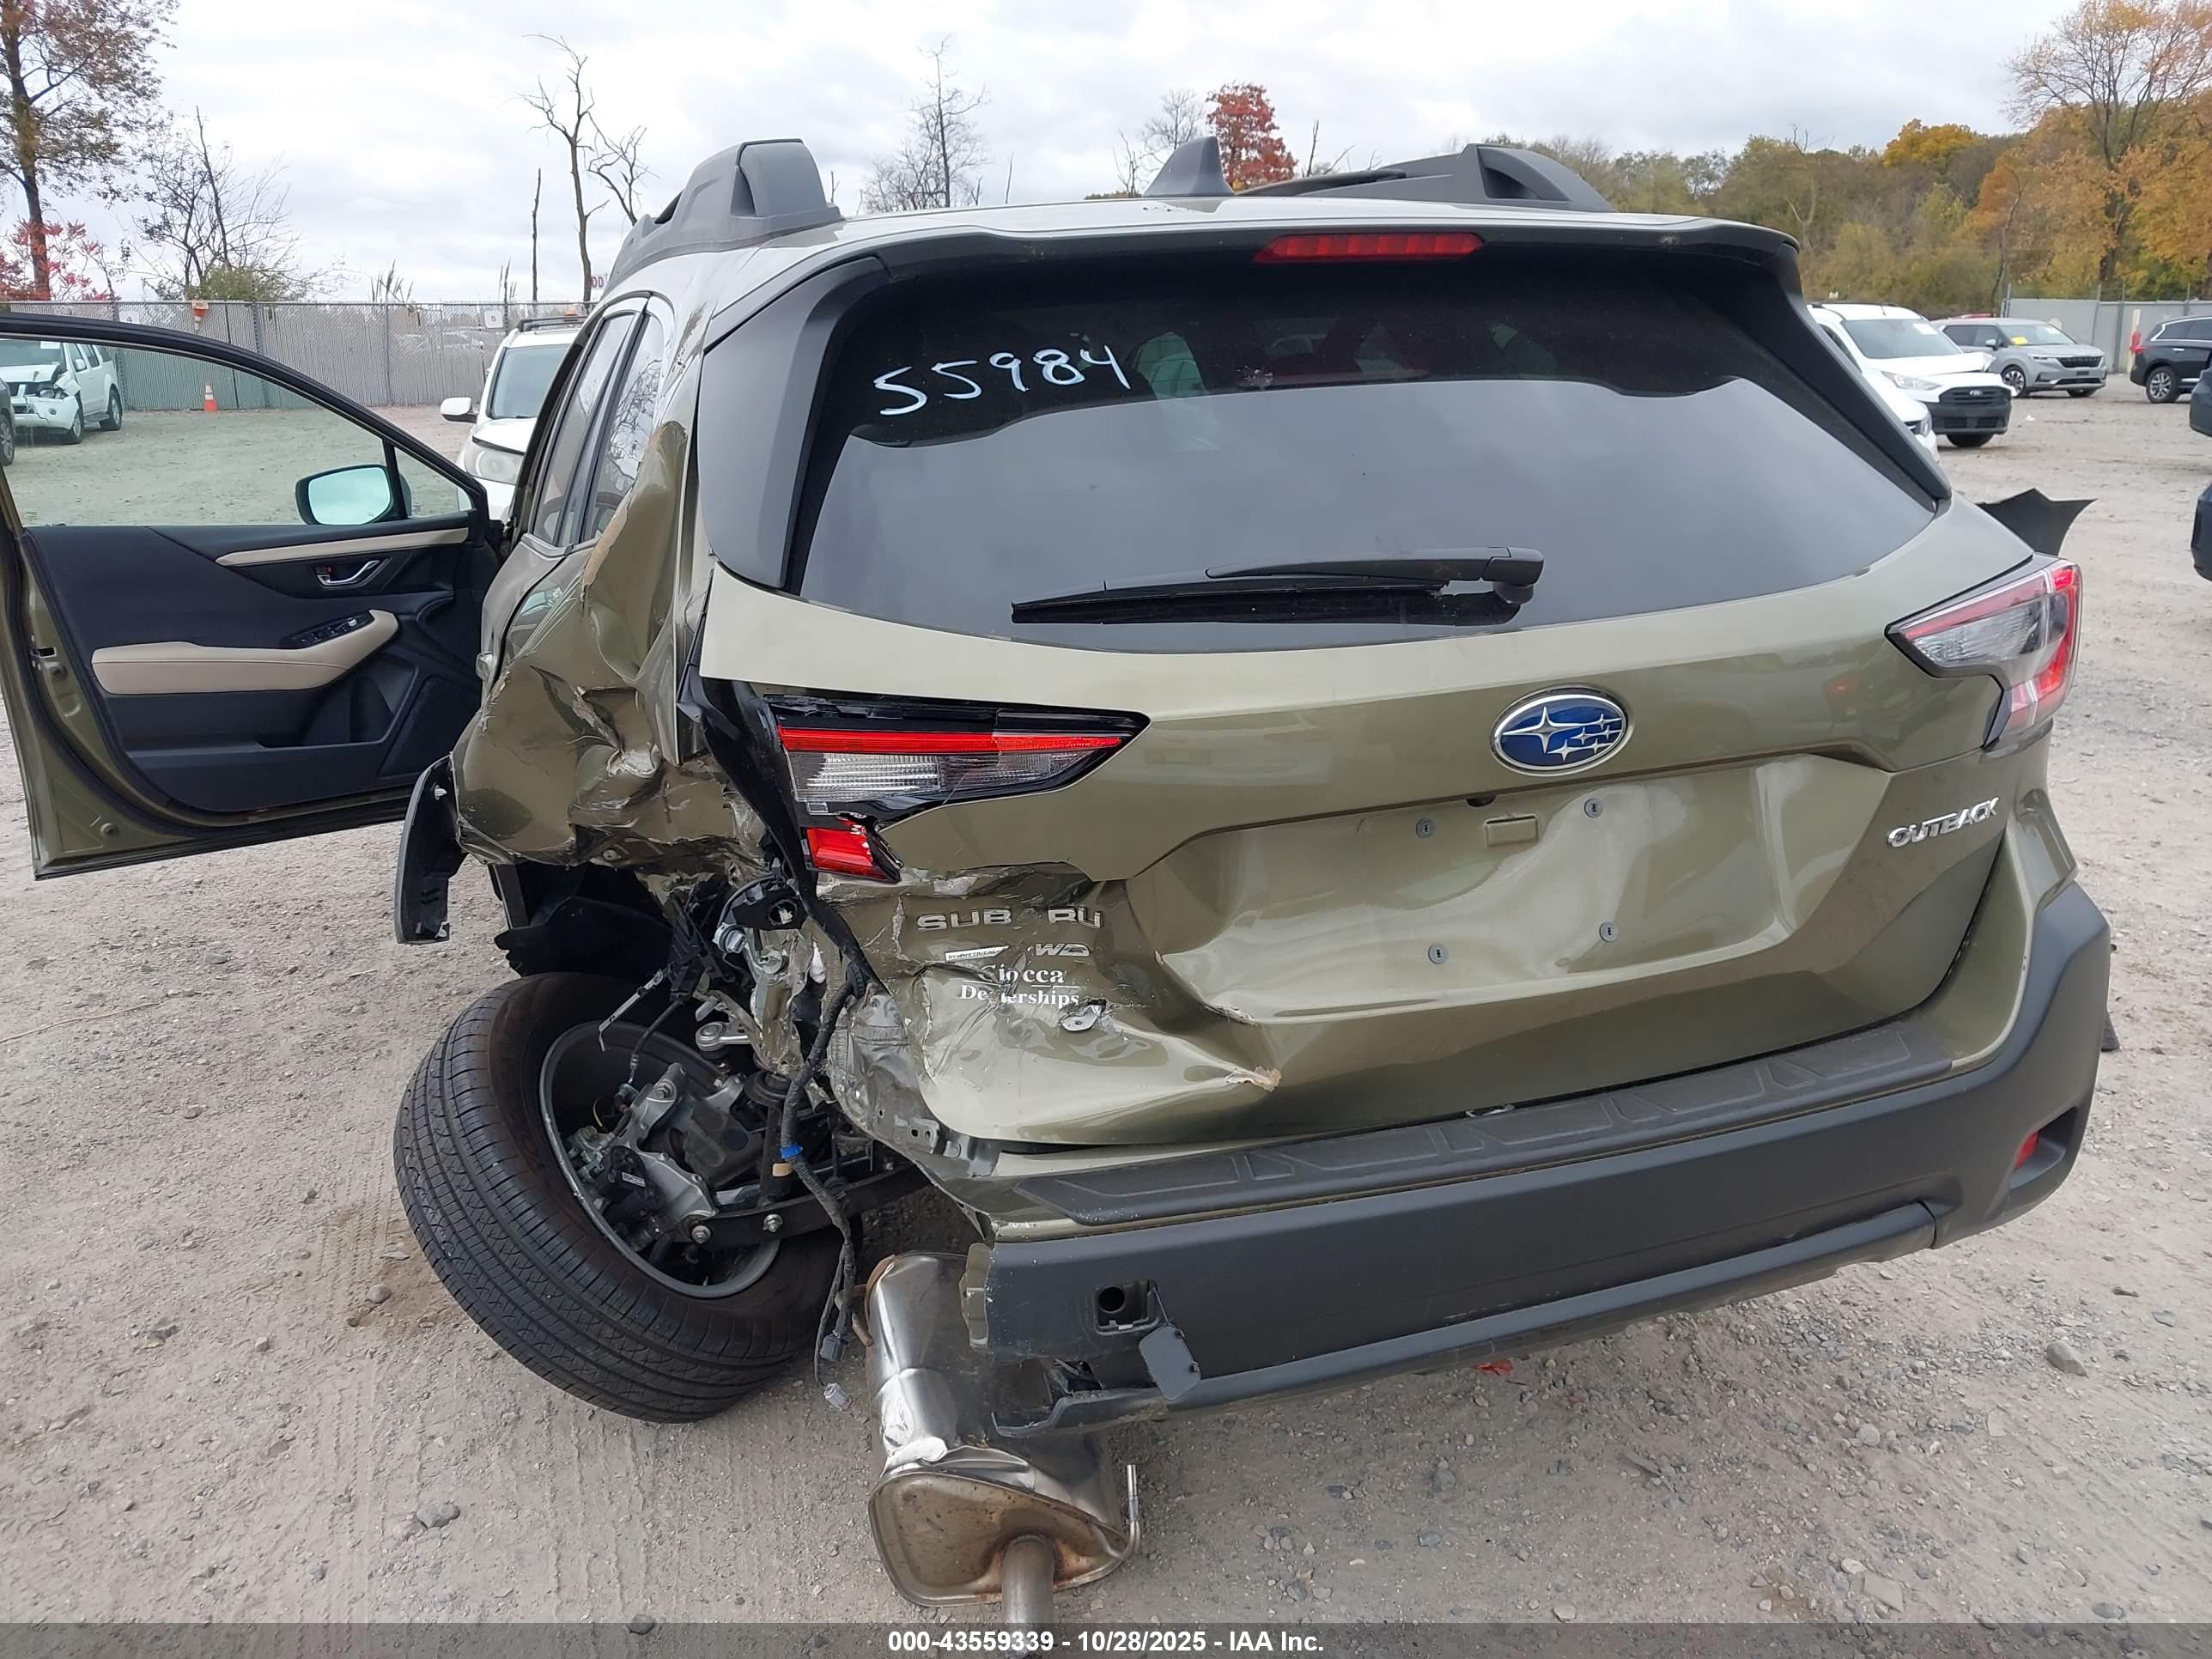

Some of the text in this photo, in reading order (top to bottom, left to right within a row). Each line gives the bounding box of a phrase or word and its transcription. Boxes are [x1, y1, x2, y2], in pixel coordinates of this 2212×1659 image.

[873, 344, 1132, 415] 55984
[1887, 797, 2000, 848] OUTBACK
[917, 907, 1102, 930] SUBRU
[977, 963, 1066, 984] Ciocca
